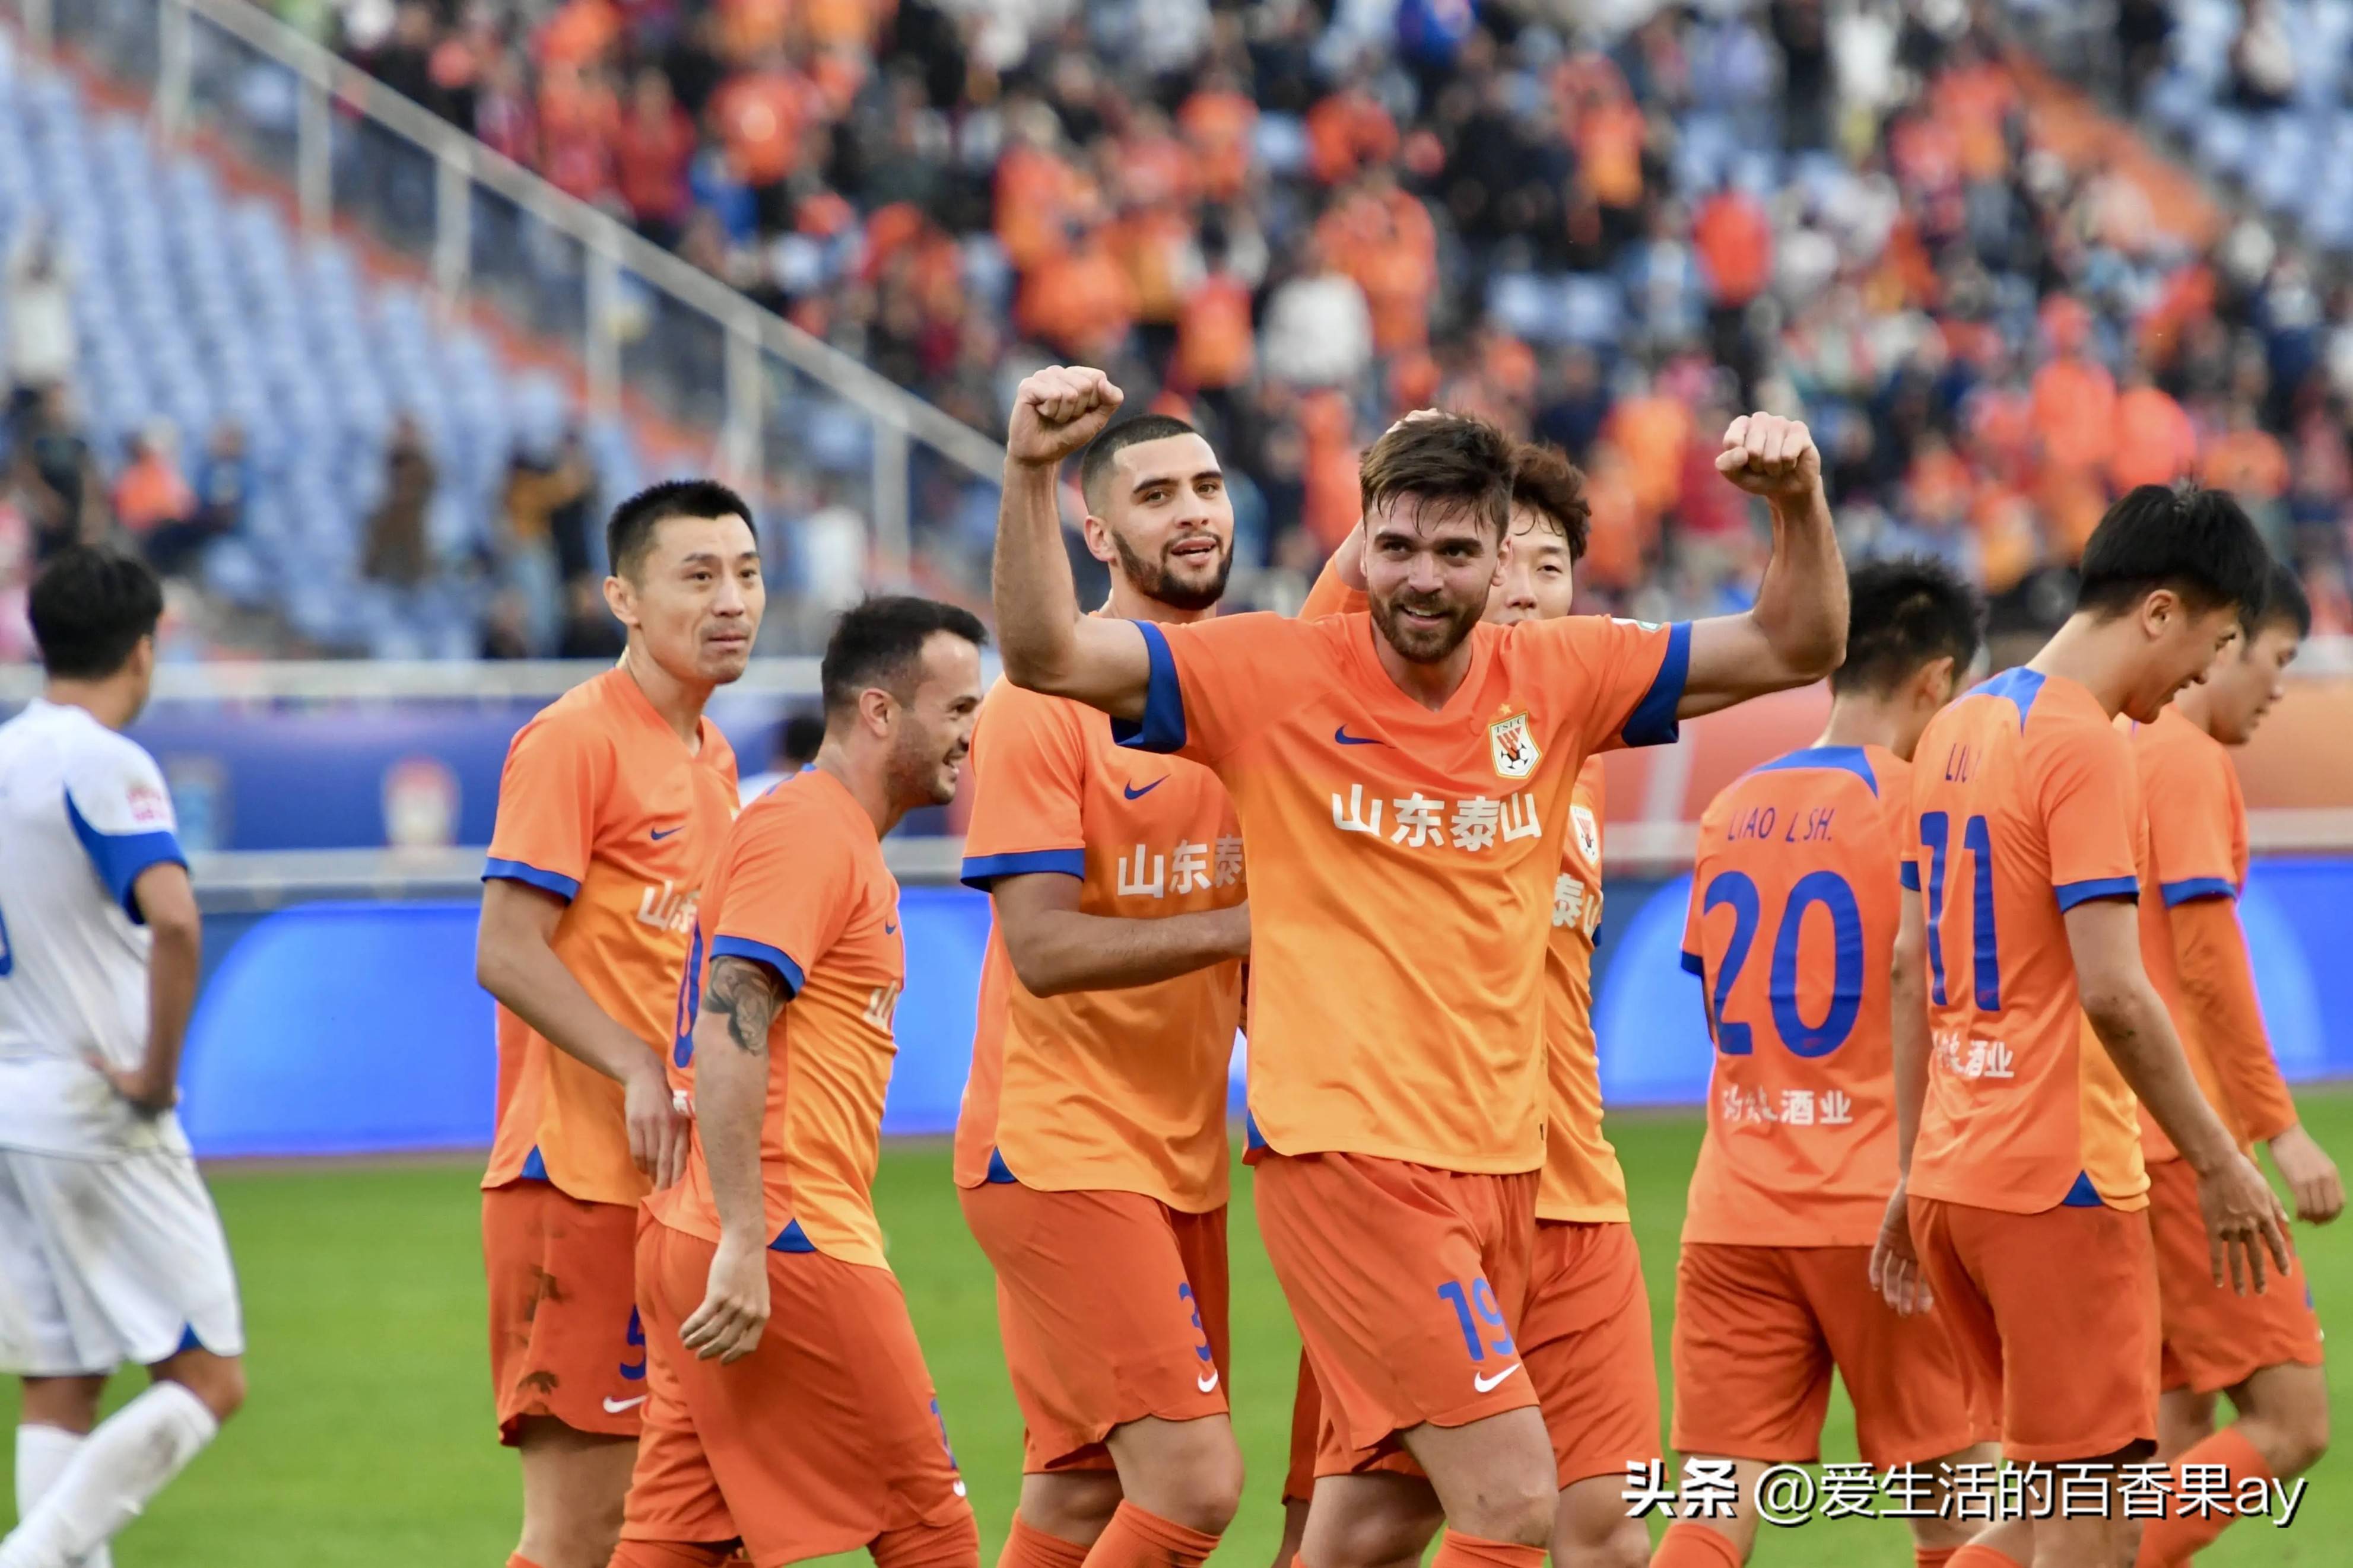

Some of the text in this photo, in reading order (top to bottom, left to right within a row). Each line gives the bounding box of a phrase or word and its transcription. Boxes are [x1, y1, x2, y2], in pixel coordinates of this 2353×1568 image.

[1495, 718, 1523, 733] TSFC
[1332, 783, 1542, 851] 山东泰山
[1728, 807, 1776, 841] LIAO
[1118, 834, 1246, 898] 山东泰
[1919, 811, 2000, 1011] 11
[1703, 870, 1864, 1058] 20
[1437, 1277, 1514, 1361] 19
